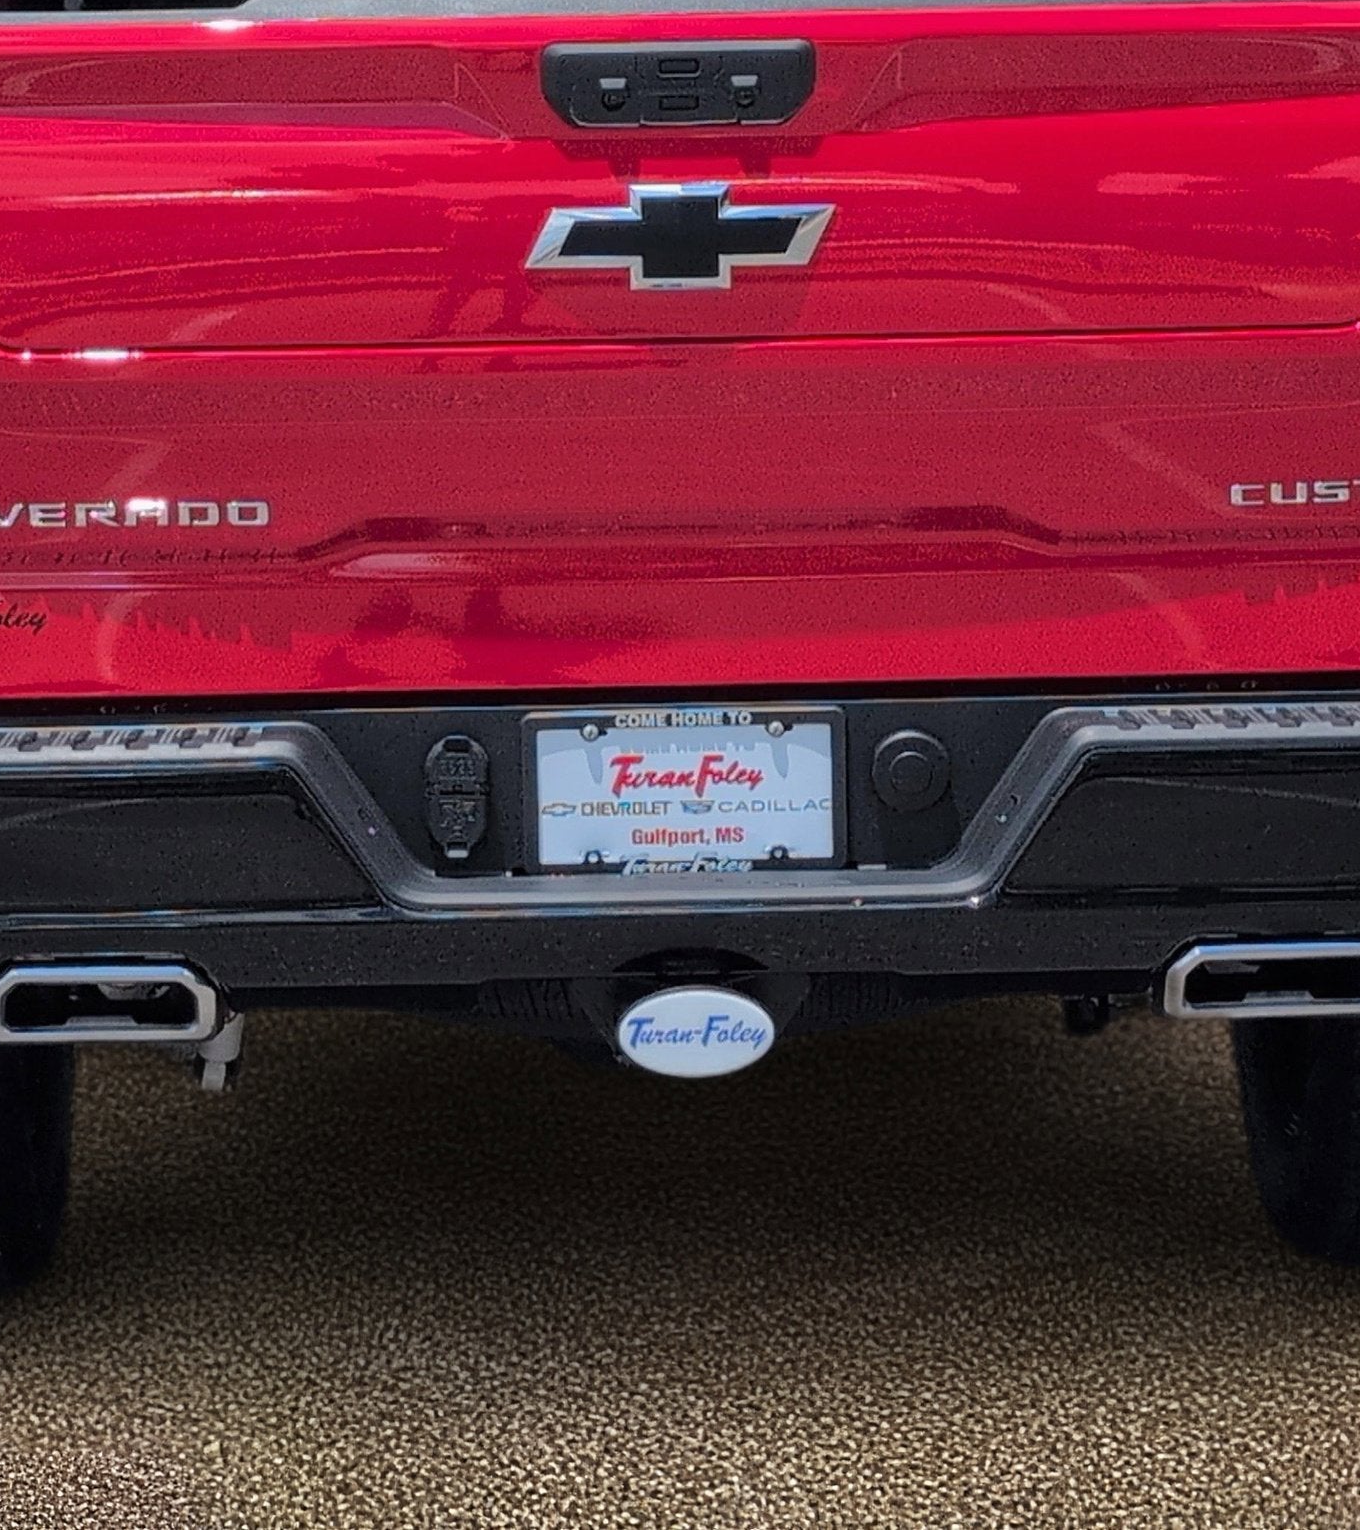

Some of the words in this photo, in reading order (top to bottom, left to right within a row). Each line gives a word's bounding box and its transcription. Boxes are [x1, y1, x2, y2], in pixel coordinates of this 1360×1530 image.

[615, 713, 667, 728] COME
[671, 711, 723, 727] HOME
[726, 711, 752, 725] TO
[609, 753, 696, 798] Turan
[694, 753, 764, 798] Foley
[580, 800, 672, 817] CHEVROLET
[631, 827, 711, 847] Gulfport,
[716, 827, 745, 843] MS
